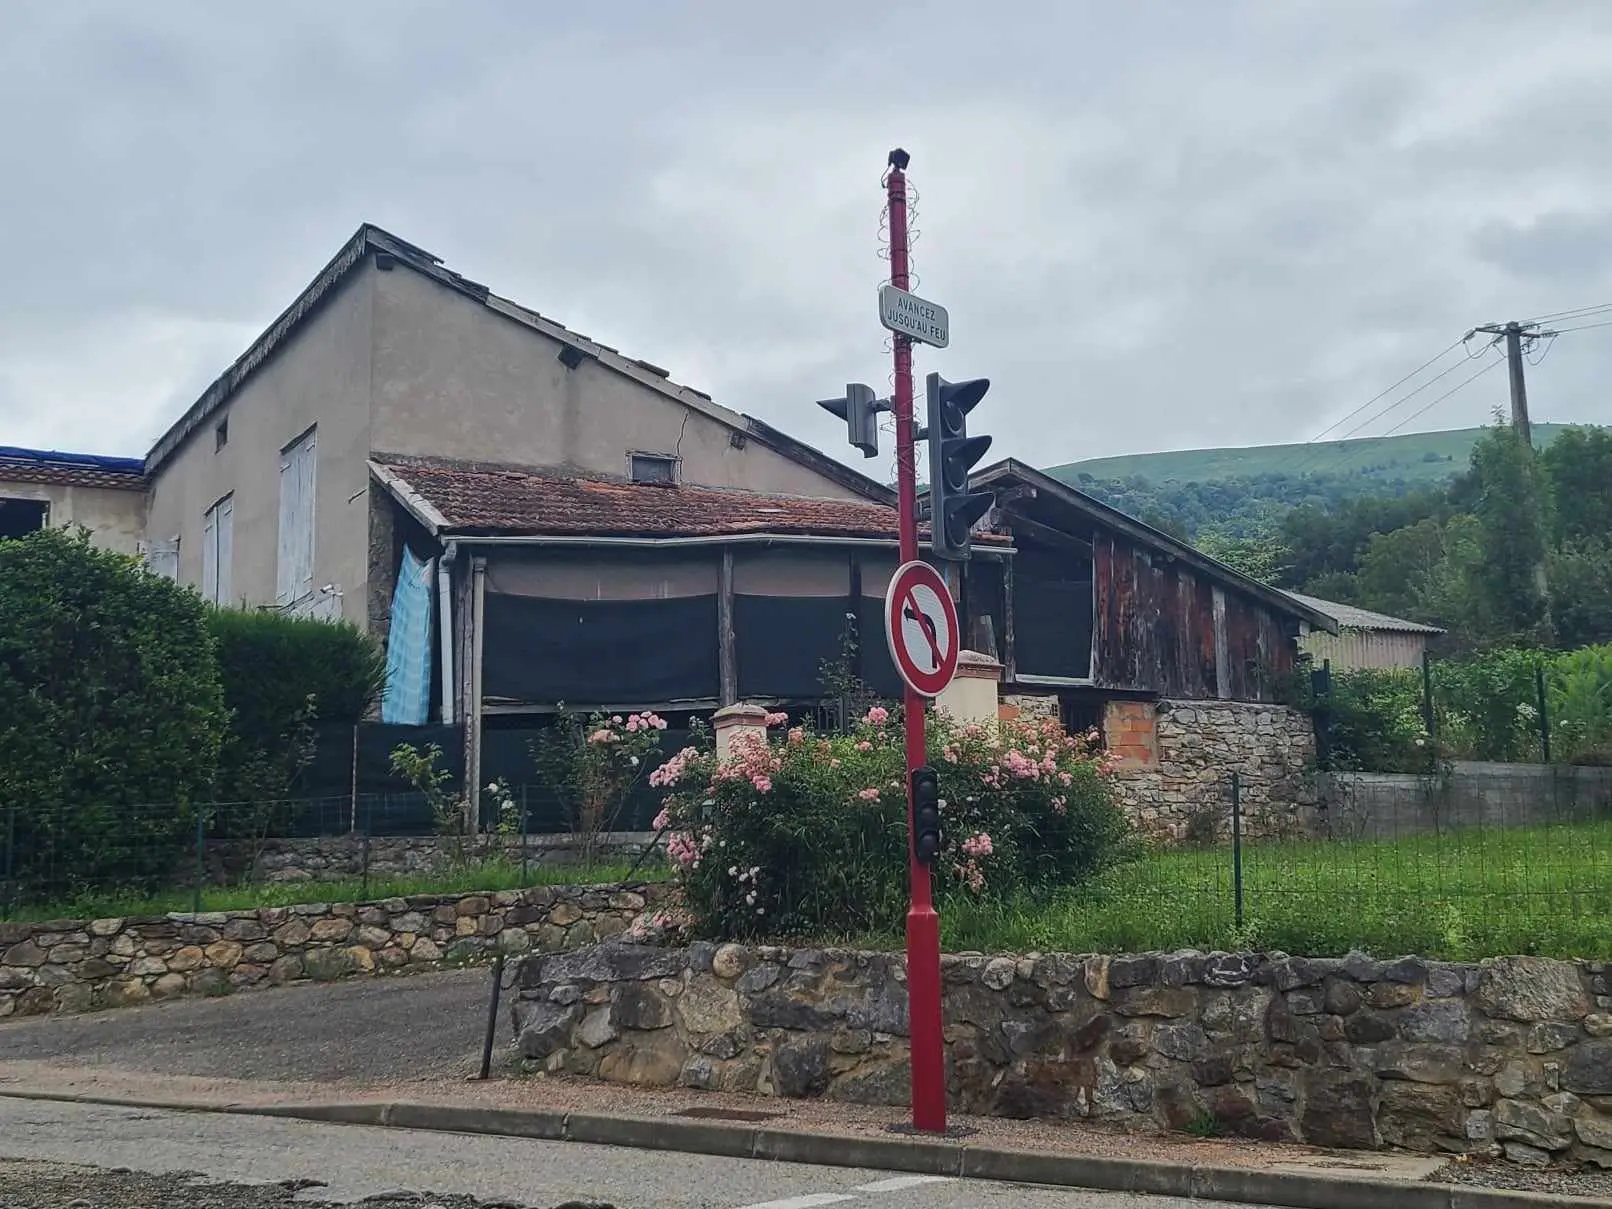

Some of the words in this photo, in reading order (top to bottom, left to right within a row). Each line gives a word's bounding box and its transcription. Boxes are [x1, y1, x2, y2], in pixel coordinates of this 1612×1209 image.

[897, 297, 936, 321] AVANCEZ
[887, 309, 927, 334] JUSQU'AU
[930, 326, 946, 340] FEU
